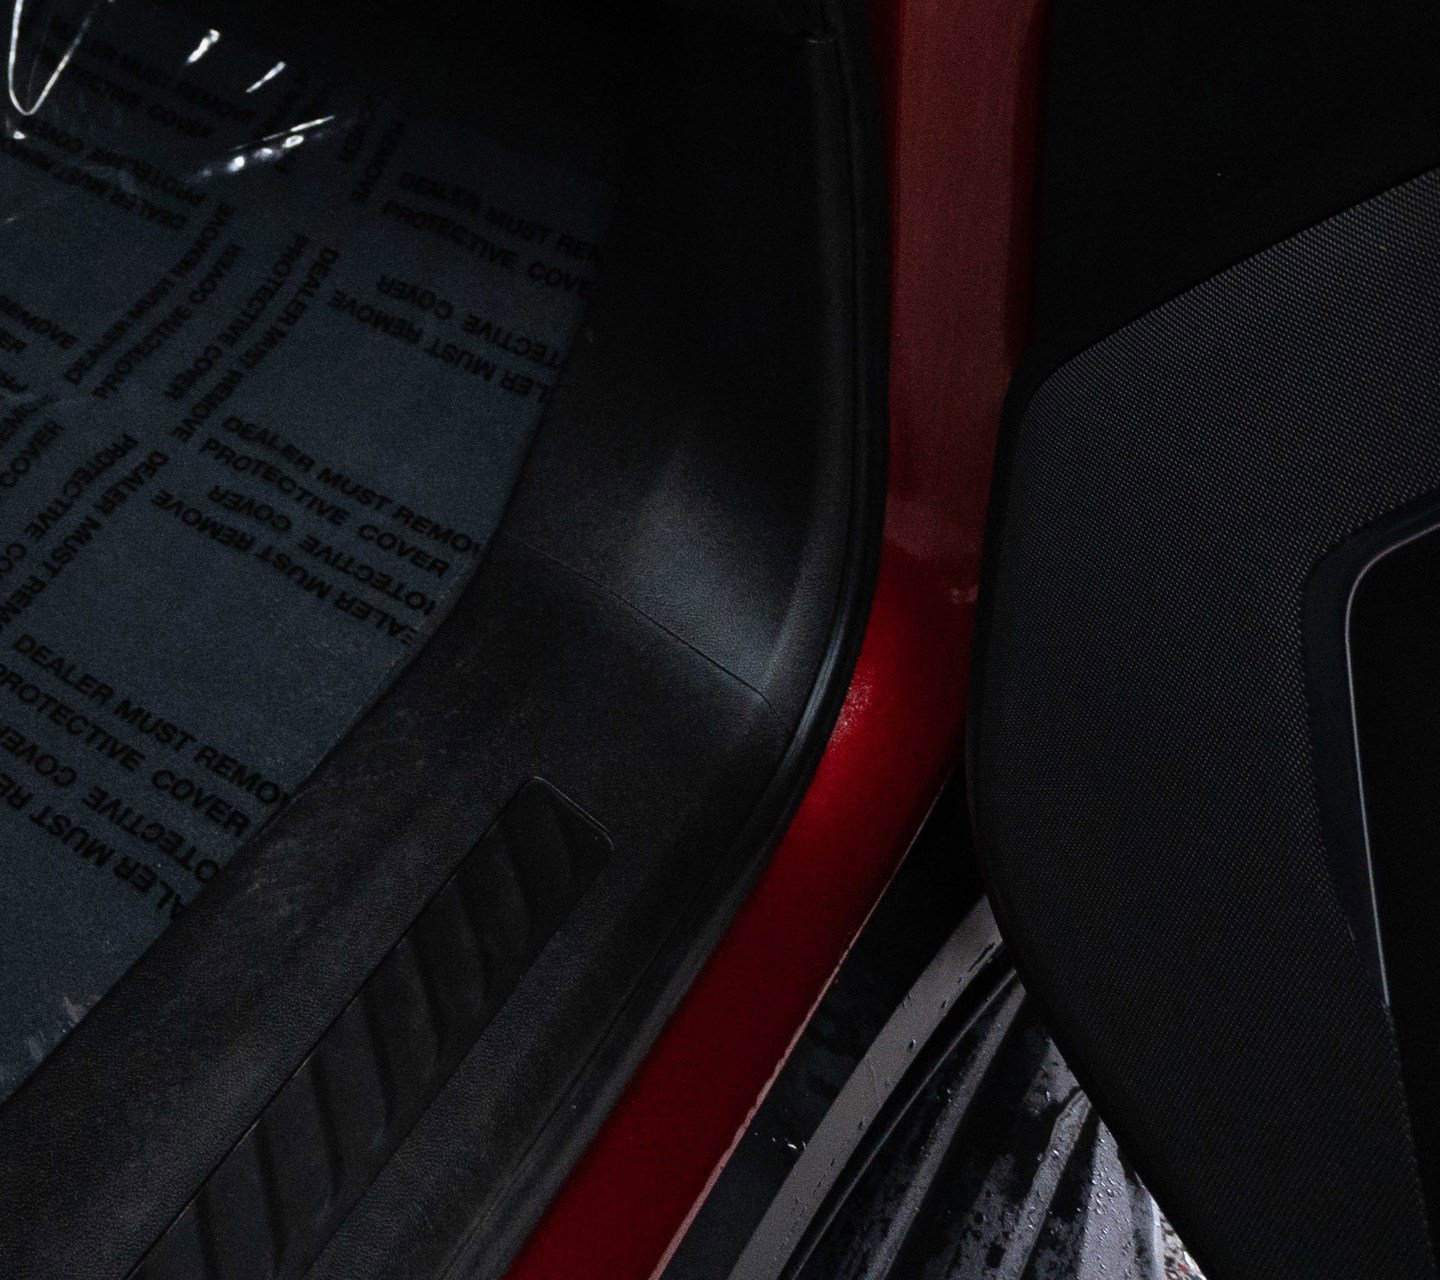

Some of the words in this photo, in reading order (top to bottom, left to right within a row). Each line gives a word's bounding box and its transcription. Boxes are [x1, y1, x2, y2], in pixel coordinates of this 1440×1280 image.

[378, 197, 520, 271] PROTECTIVE
[481, 204, 554, 247] MUST
[62, 314, 135, 387] DEALER
[169, 198, 238, 282] REMOVE
[89, 300, 196, 404] PROTECTIVE
[185, 238, 246, 308] COVER
[217, 228, 312, 349] PROTECTIVE
[275, 242, 342, 329] DEALER
[327, 288, 426, 345] REMOVE
[372, 272, 457, 323] COVER
[162, 340, 225, 405] COVER
[236, 320, 288, 372] MUST
[423, 334, 498, 383] MUST
[169, 363, 246, 446] REMOVE
[20, 429, 139, 545] PROTECTIVE
[91, 445, 171, 519] DEALER
[220, 410, 317, 474] DEALER
[316, 464, 393, 515] MUST
[149, 485, 258, 554] REMOVE
[198, 434, 352, 529] PROTECTIVE
[354, 519, 451, 580] COVER
[205, 481, 294, 536] COVER
[39, 513, 103, 578] MUST
[253, 539, 334, 602] MUST
[11, 630, 117, 708] DEALER
[112, 695, 197, 757] MUST
[27, 798, 116, 870] MUST
[147, 764, 253, 839] COVER
